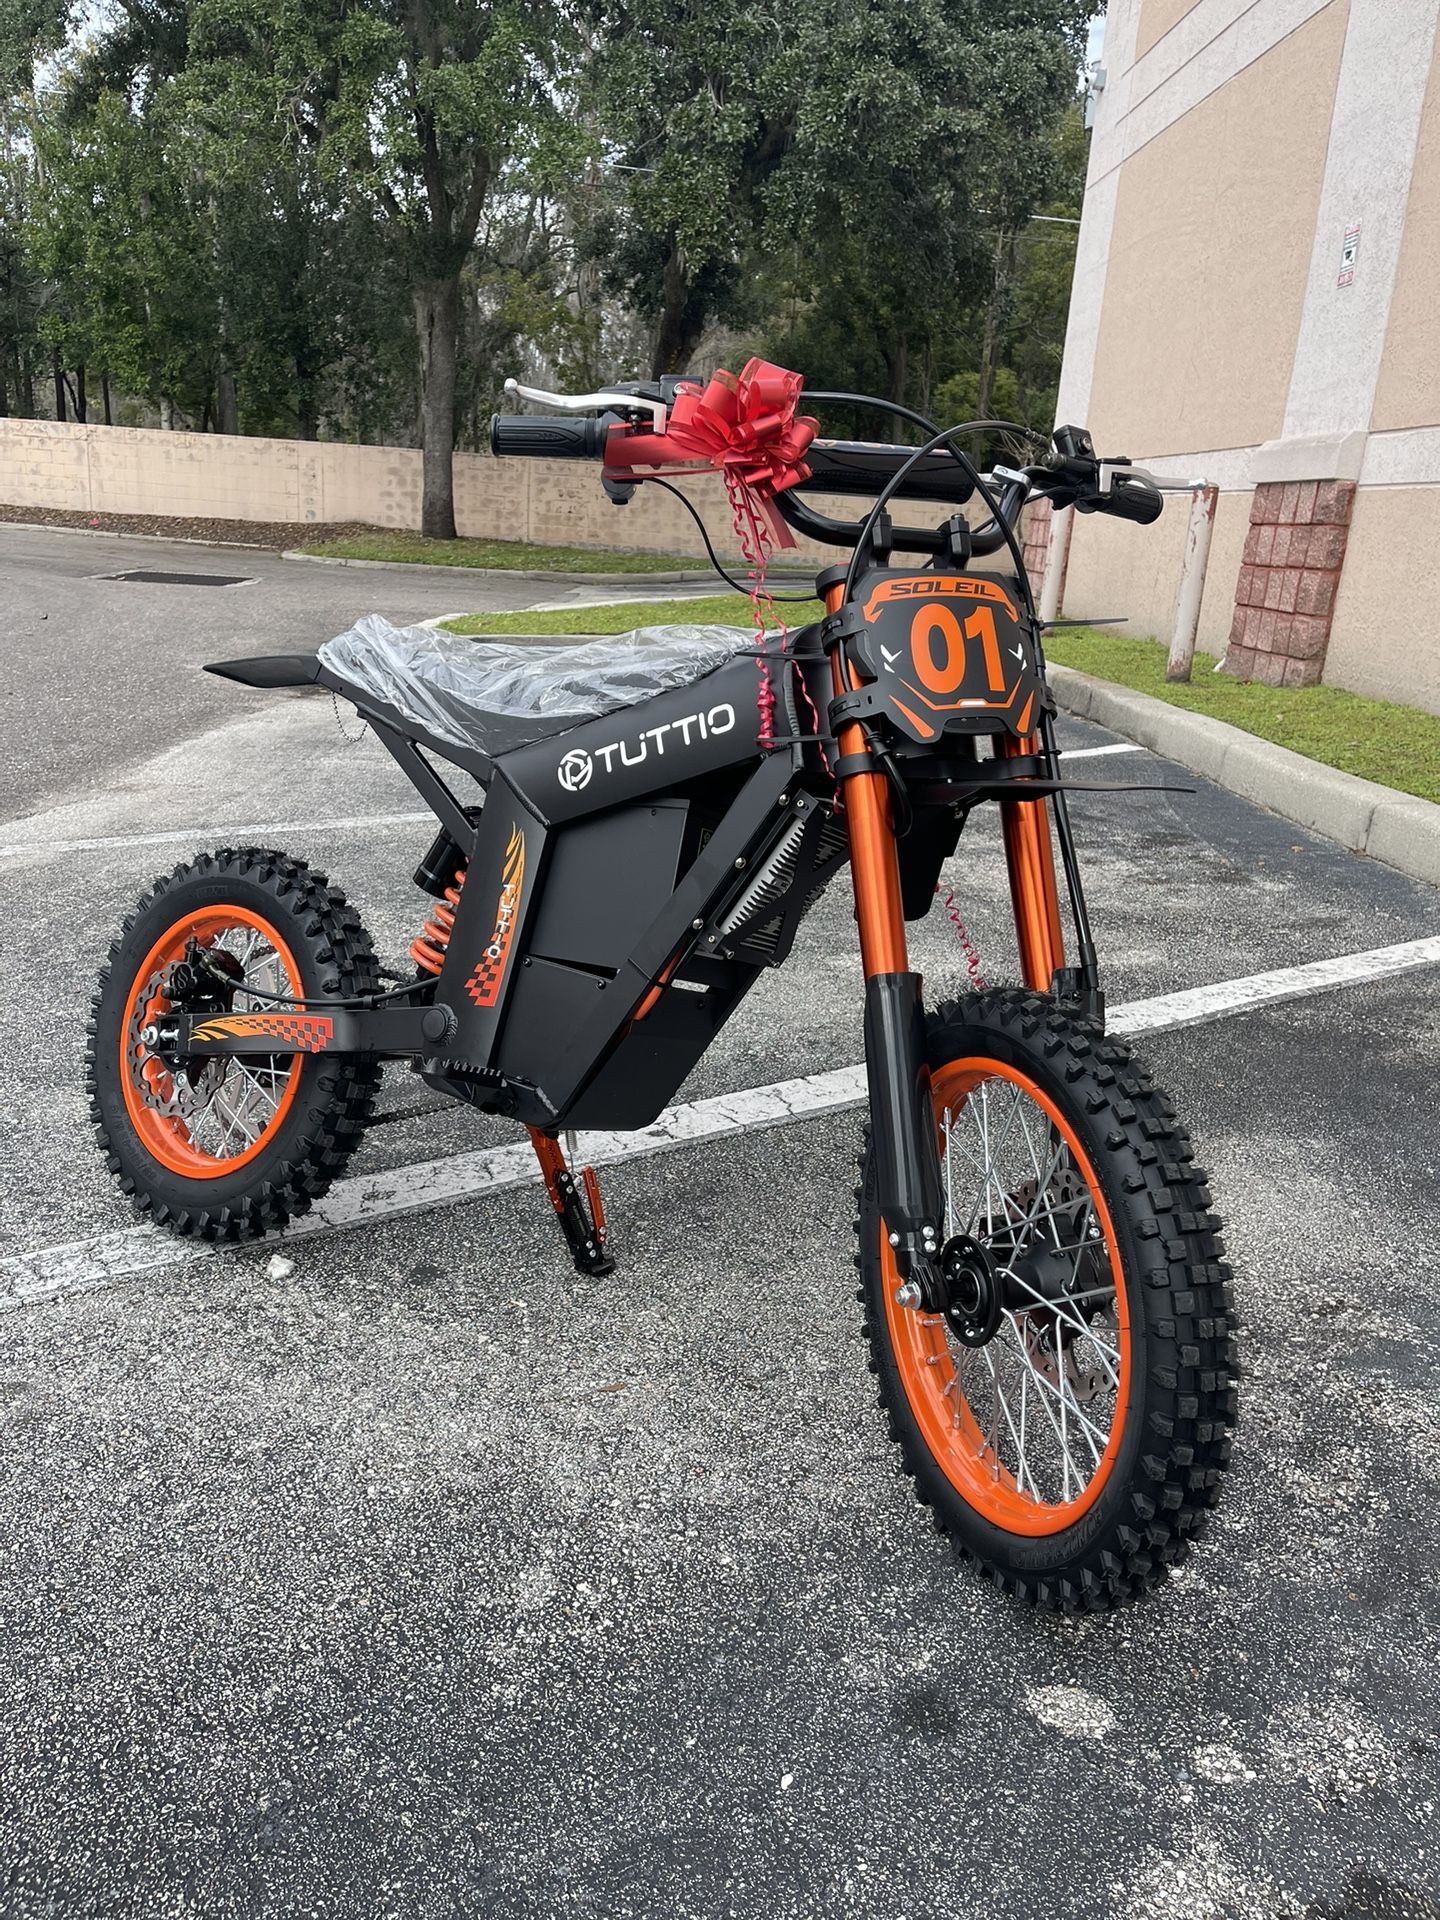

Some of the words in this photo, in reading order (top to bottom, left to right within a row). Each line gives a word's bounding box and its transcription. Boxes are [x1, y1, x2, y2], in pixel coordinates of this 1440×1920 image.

[889, 581, 996, 597] SOLEIL
[910, 603, 1006, 694] 01
[594, 703, 736, 773] TUTTIO
